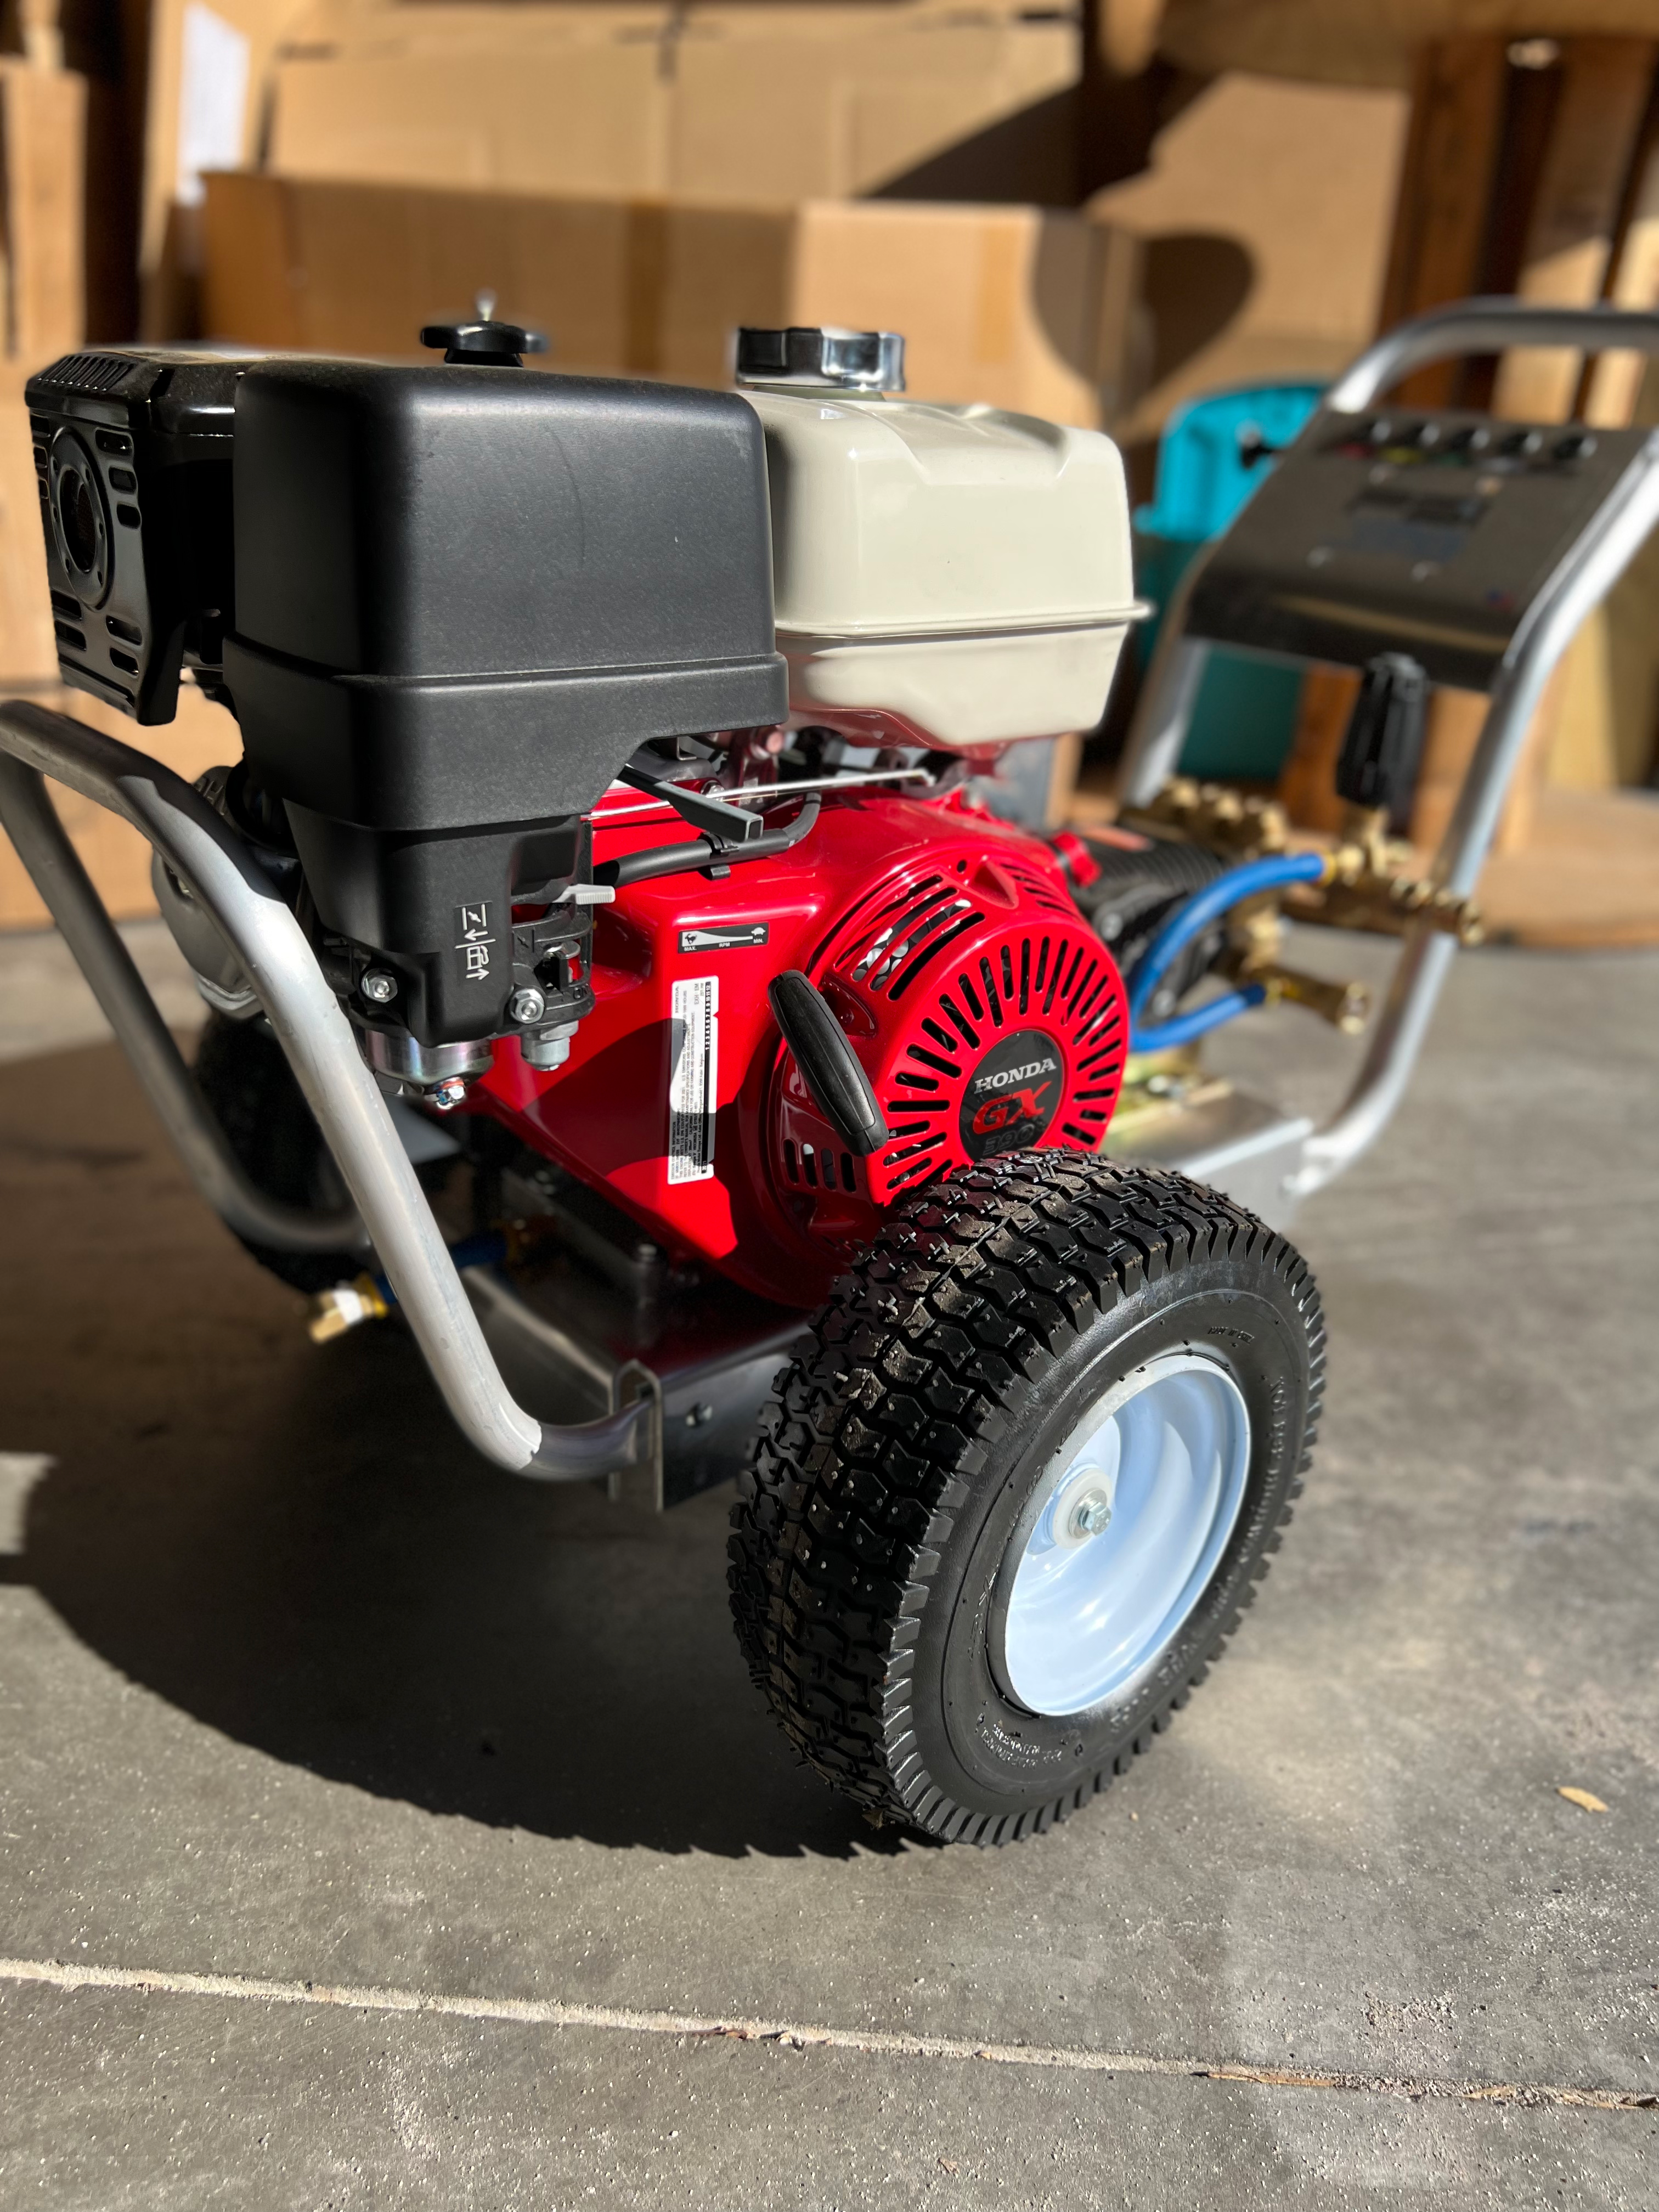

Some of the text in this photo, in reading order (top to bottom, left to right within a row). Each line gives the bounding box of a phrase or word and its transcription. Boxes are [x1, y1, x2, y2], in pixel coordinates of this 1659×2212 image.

[974, 1057, 1057, 1094] HONDA
[972, 1081, 1052, 1135] GX
[983, 1124, 1035, 1156] 390
